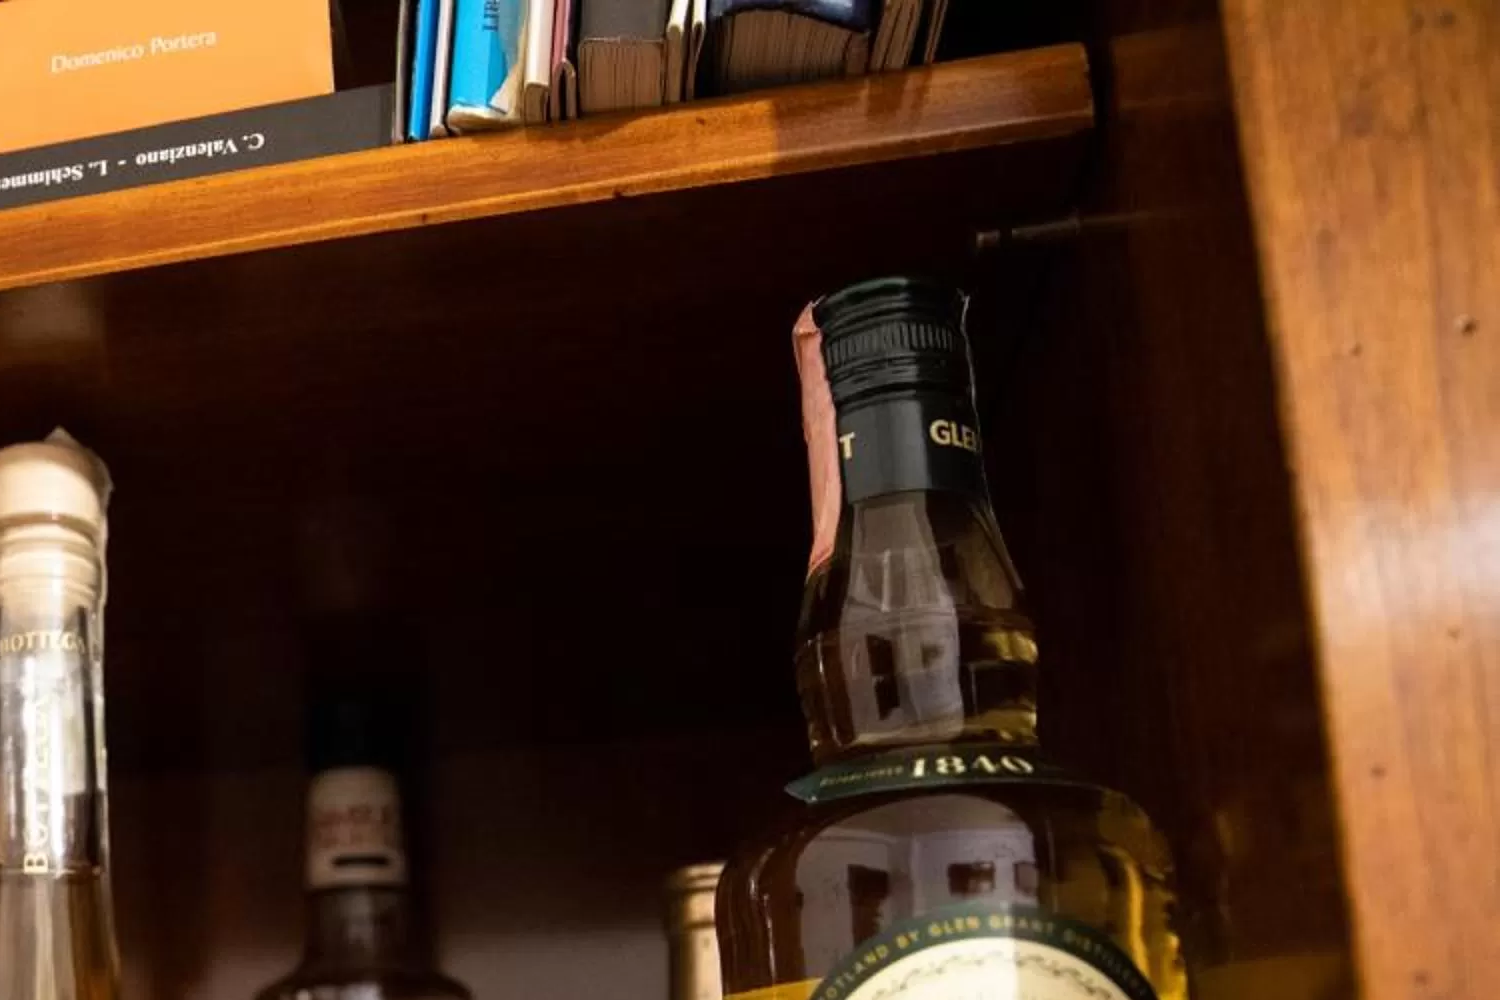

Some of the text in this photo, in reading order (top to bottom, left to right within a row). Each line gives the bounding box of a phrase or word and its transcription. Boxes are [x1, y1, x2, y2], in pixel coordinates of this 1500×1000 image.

[51, 30, 217, 74] Domenico Portera
[135, 138, 238, 166] Valenziano
[242, 132, 265, 151] C.
[929, 418, 982, 453] GLE
[911, 755, 1034, 778] 1840
[929, 914, 980, 937] GLEN
